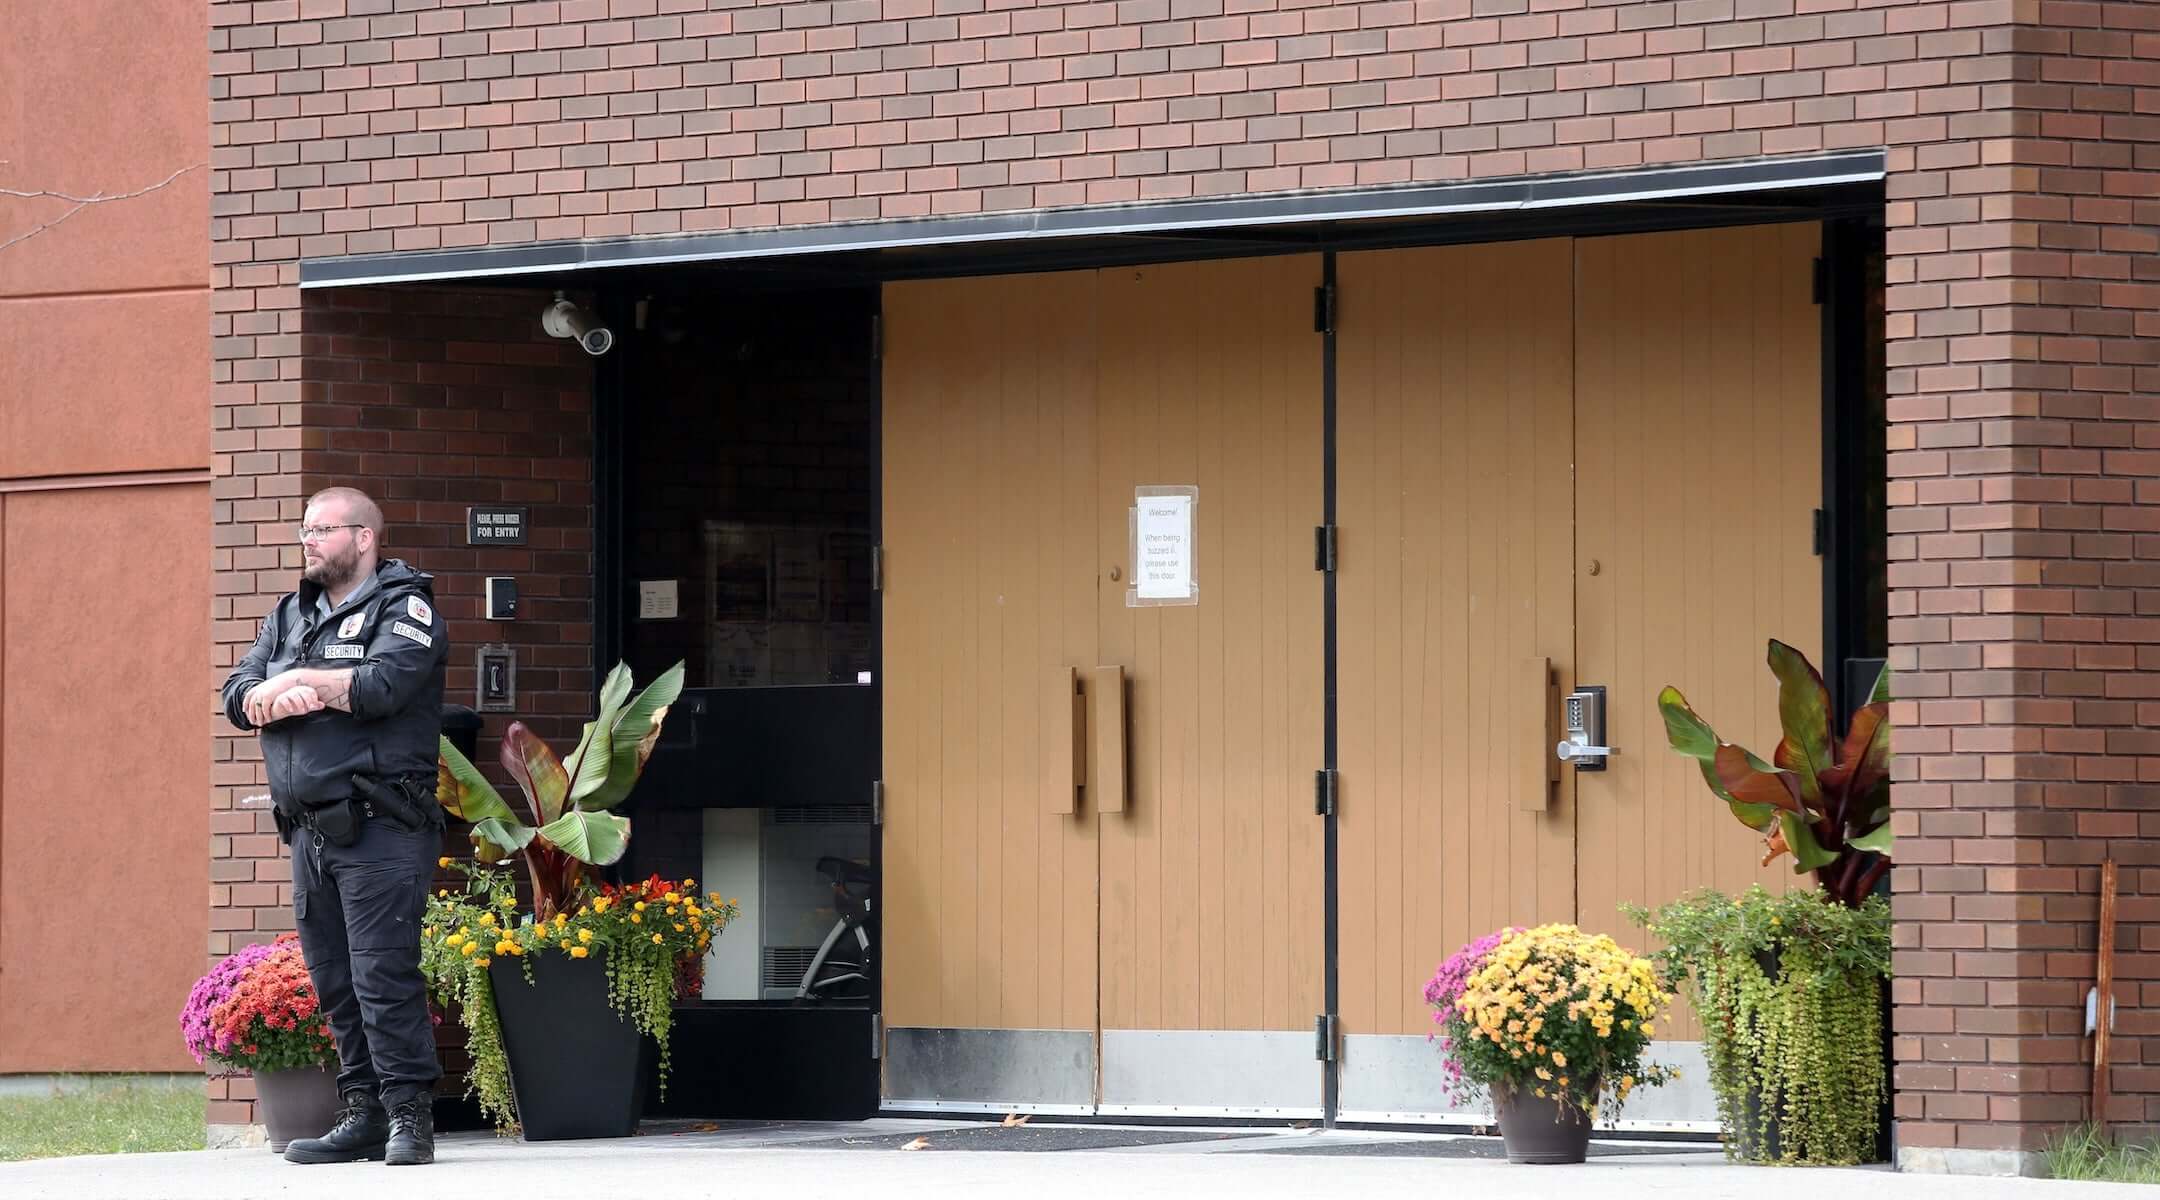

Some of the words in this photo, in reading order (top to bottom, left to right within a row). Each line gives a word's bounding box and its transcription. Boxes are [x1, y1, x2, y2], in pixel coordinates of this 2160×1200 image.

[477, 527, 492, 537] FOR
[495, 527, 519, 537] ENTRY
[1145, 533, 1162, 542] When
[1163, 533, 1181, 543] being
[1145, 559, 1167, 568] please
[1168, 559, 1179, 567] use
[395, 624, 430, 644] SECURITY
[326, 646, 362, 657] SECURITY
